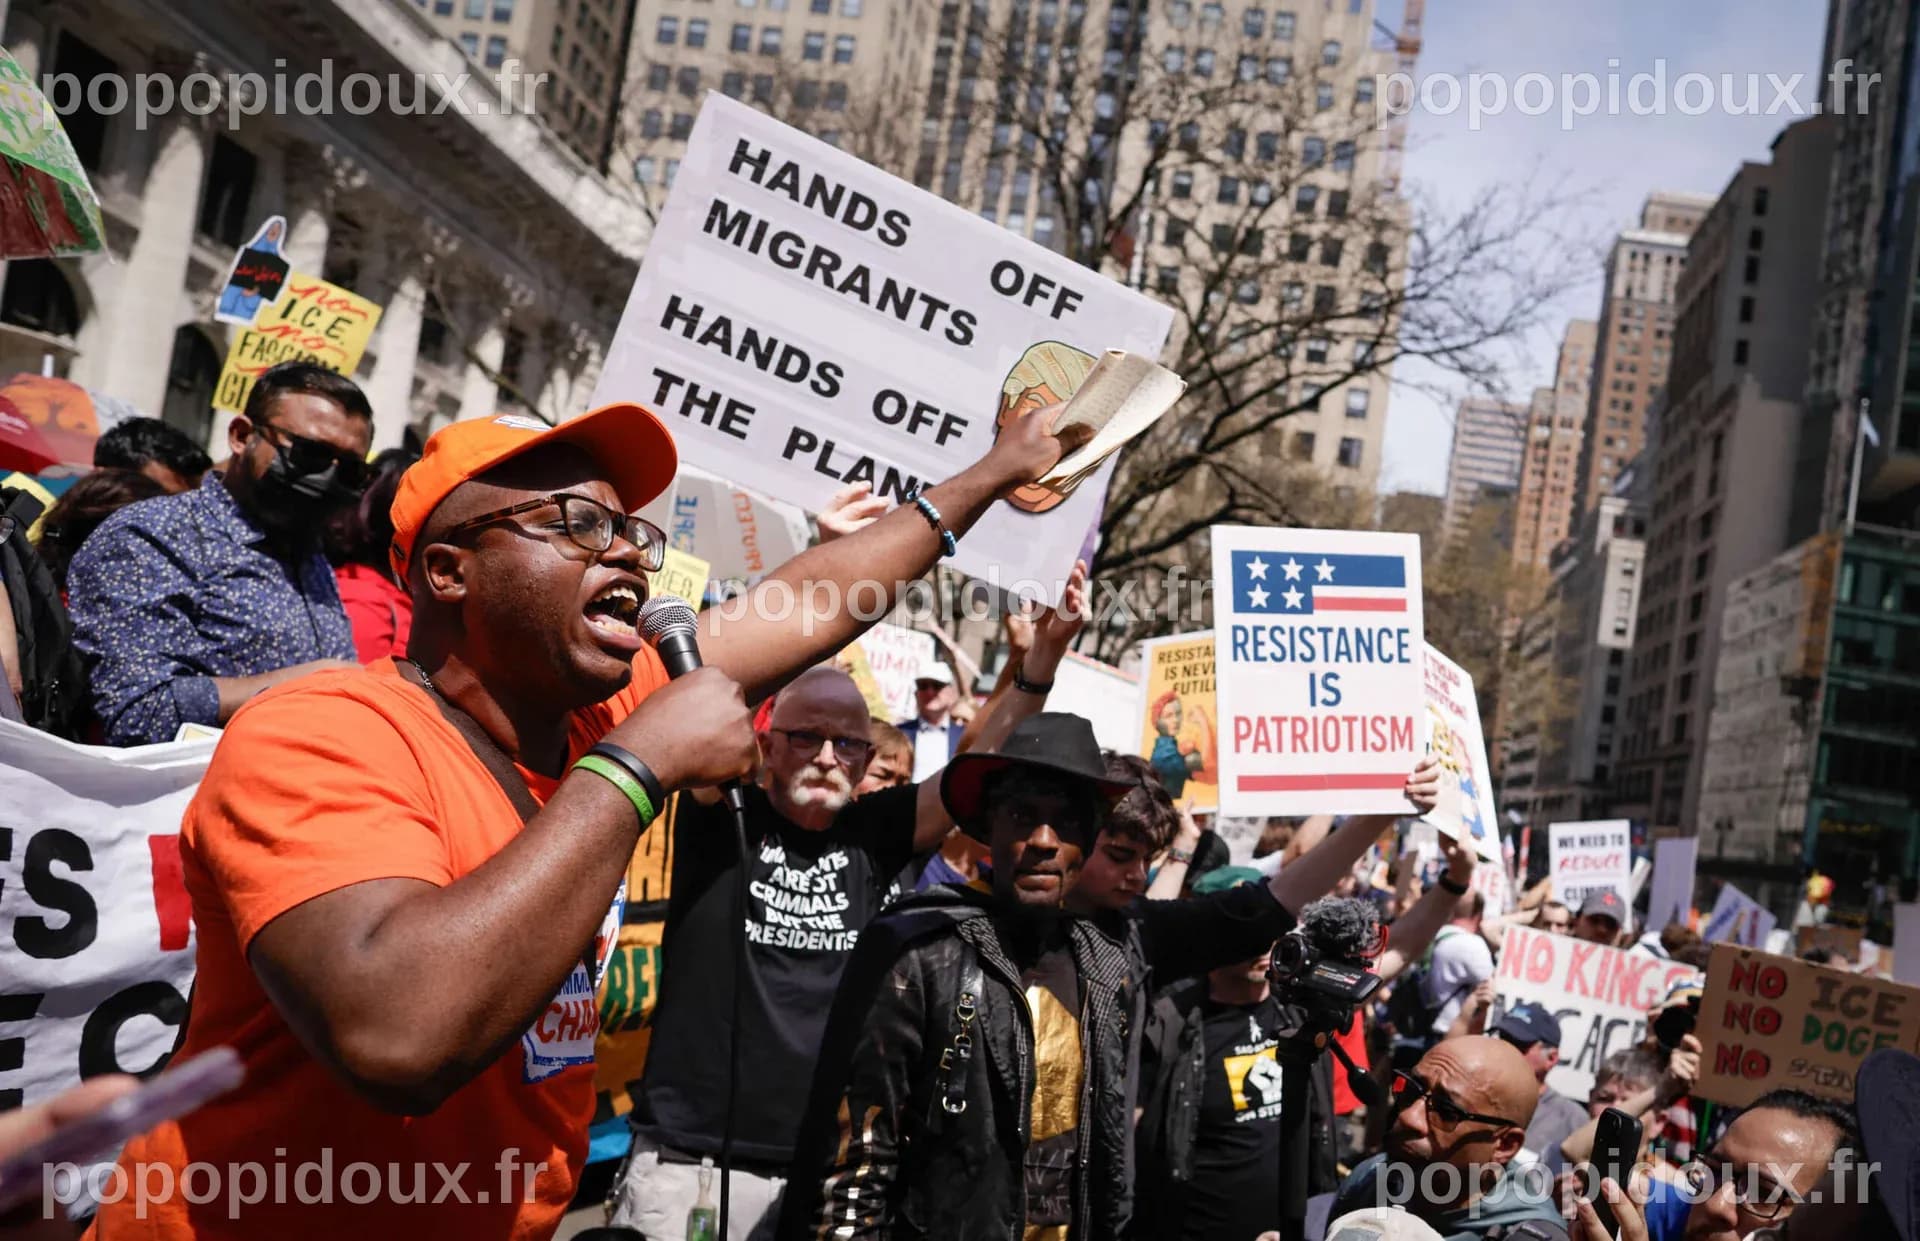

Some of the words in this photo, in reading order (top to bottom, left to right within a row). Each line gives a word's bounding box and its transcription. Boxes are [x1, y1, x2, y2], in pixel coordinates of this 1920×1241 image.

[728, 138, 911, 247] HANDS
[990, 260, 1084, 320] OFF
[703, 199, 977, 347] MIGRANTS
[660, 294, 844, 398] HANDS
[872, 389, 969, 446] OFF
[652, 367, 756, 440] THE
[782, 426, 936, 505] PLAN
[1232, 624, 1410, 664] RESISTANCE
[1165, 666, 1177, 680] IS
[1309, 672, 1342, 707] IS
[1234, 716, 1414, 753] PATRIOTISM
[1610, 833, 1624, 846] TO
[1501, 928, 1555, 984] NO
[1727, 959, 1788, 1000] NO
[1810, 976, 1907, 1029] ICE
[1721, 1000, 1783, 1037] NO
[1802, 1012, 1899, 1057] DOGE
[1713, 1041, 1772, 1081] NO
